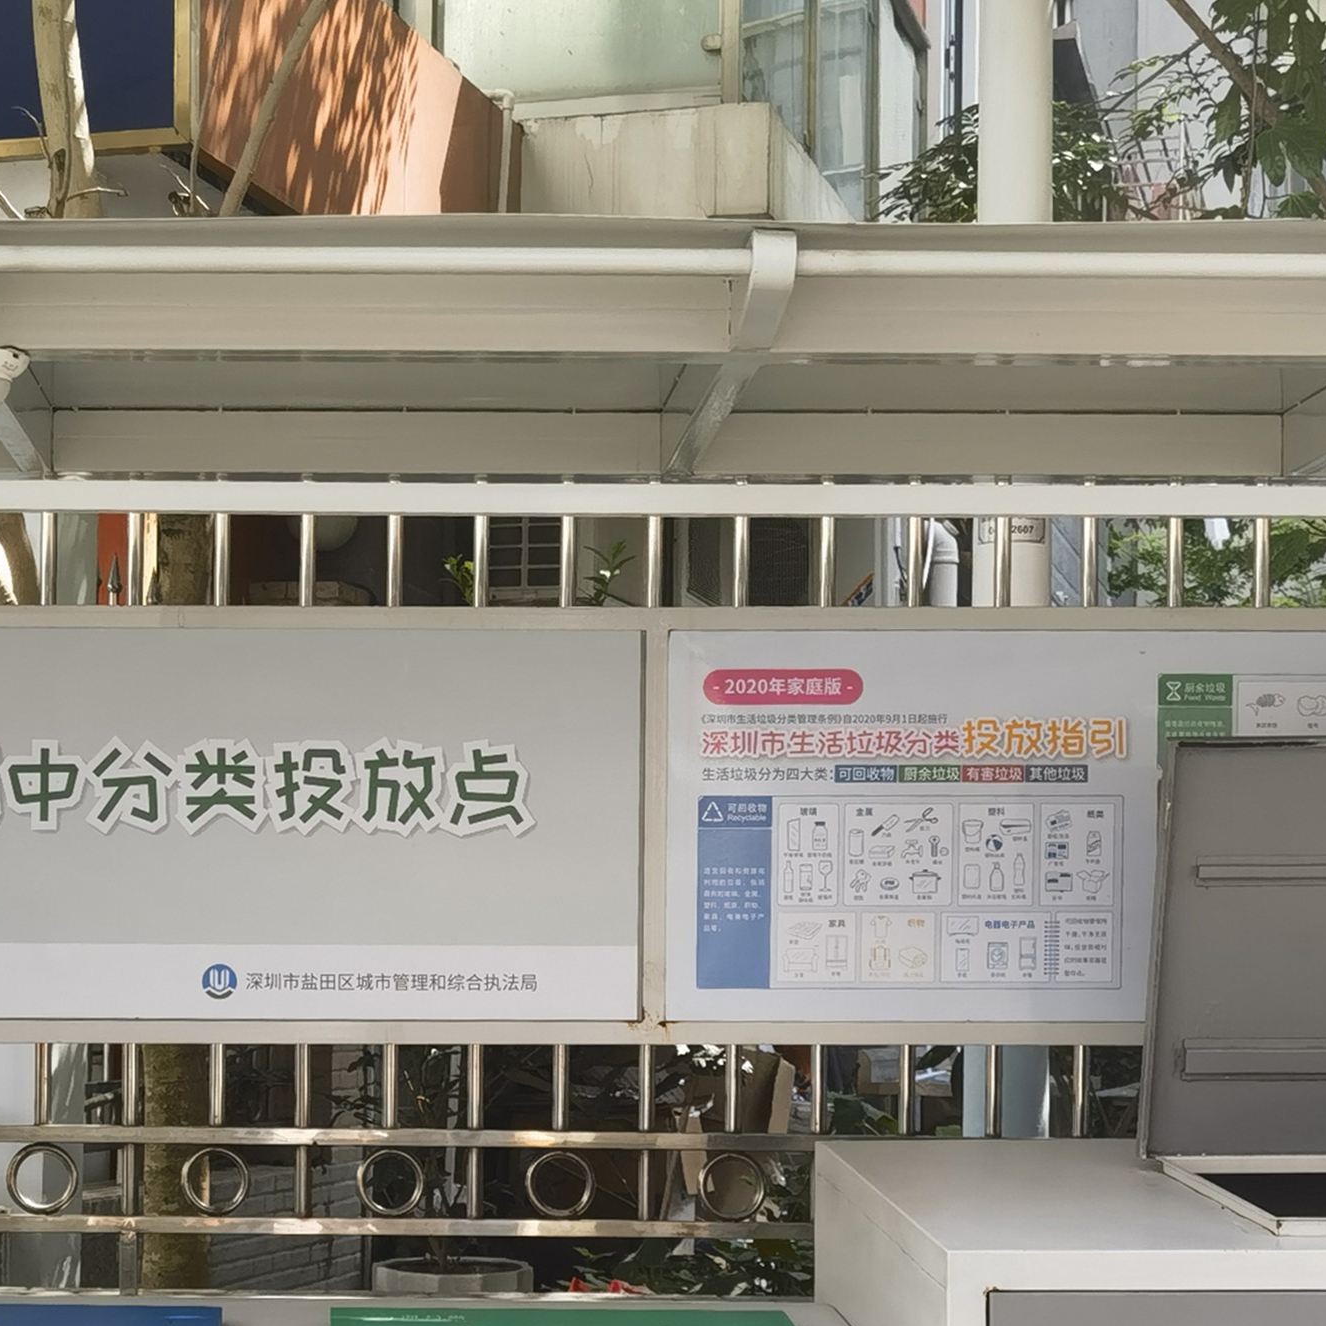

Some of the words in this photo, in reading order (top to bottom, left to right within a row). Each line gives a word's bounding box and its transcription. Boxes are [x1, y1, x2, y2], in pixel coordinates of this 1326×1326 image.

[1184, 682, 1226, 693] 厨余垃圾
[838, 767, 895, 782] 可回收物
[903, 767, 960, 782] 厨余垃圾
[966, 767, 1023, 782] 有害垃圾
[1028, 767, 1086, 782] 其他垃圾
[727, 803, 767, 814] 可回收物
[800, 807, 817, 816] 玻璃
[855, 807, 874, 817] 金属
[984, 920, 1035, 929] 电器电子产品
[246, 973, 537, 991] 深圳市盐田区城市管理和综合执法局
